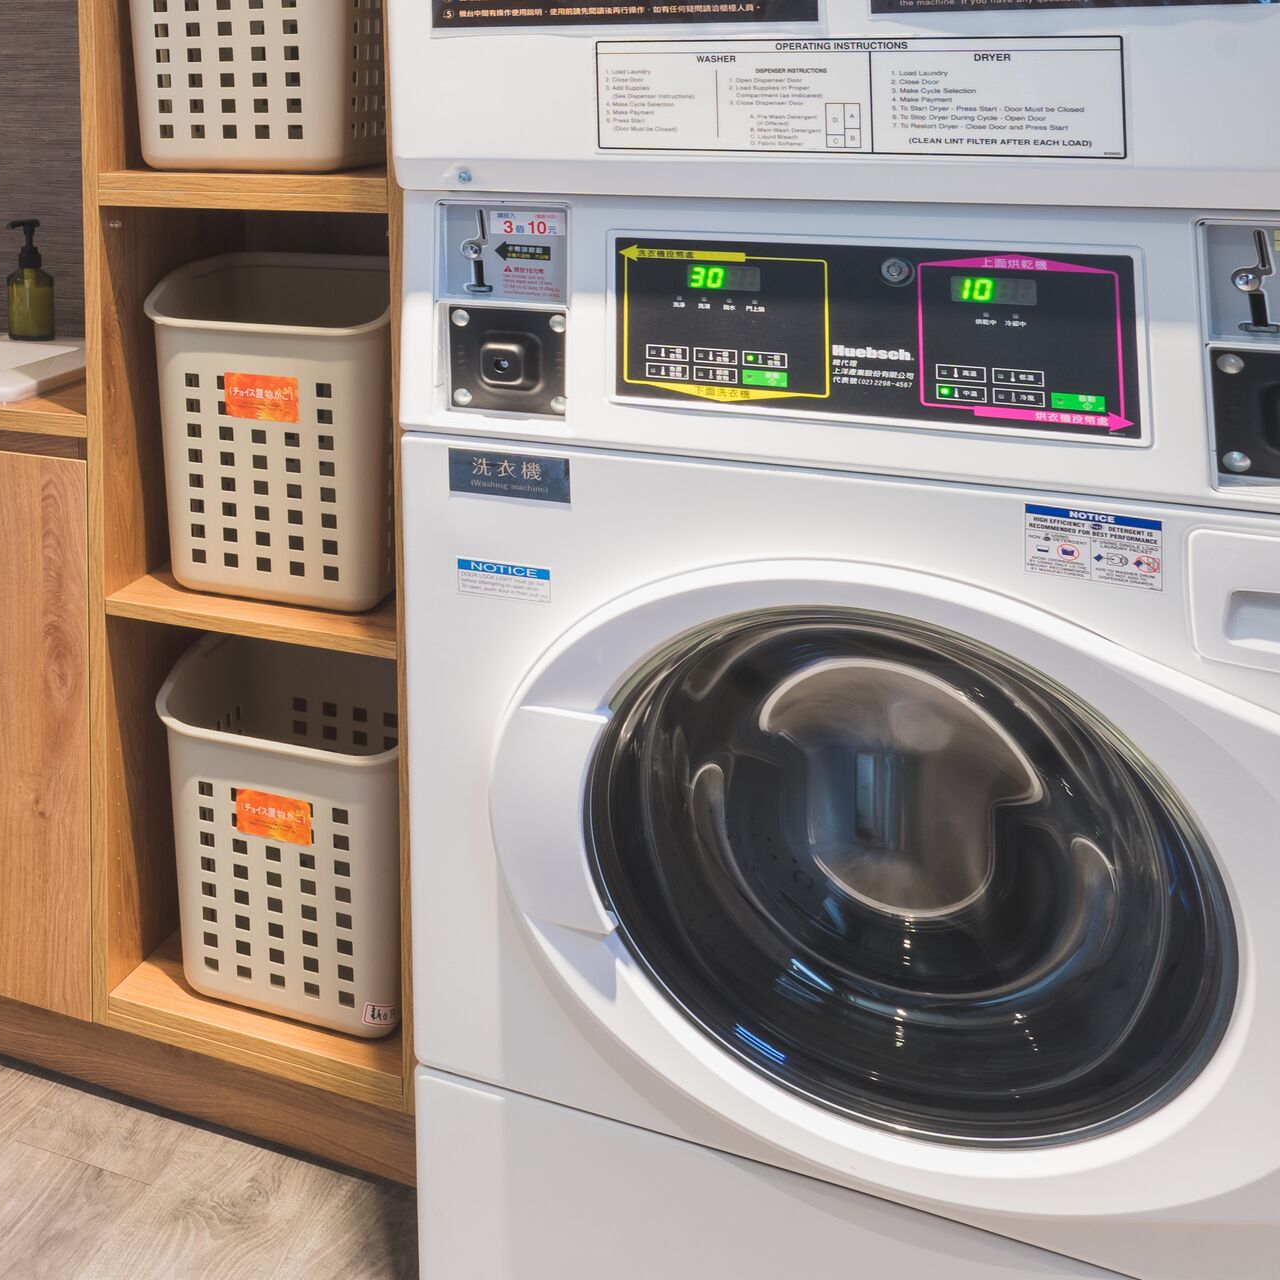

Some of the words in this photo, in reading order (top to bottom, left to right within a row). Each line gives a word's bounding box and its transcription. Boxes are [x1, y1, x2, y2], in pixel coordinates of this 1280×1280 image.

[775, 42, 831, 51] OPERATING
[833, 41, 908, 51] INSTRUCTIONS
[696, 55, 736, 63] WASHER
[973, 53, 1011, 62] DRYER
[1062, 139, 1092, 148] LOAD)
[981, 259, 1048, 270] 上面烘乾機
[691, 266, 725, 289] 30
[961, 278, 993, 300] 10
[696, 386, 750, 399] 下面洗衣機
[472, 457, 542, 481] 洗衣機
[471, 480, 509, 490] (Washing
[511, 483, 549, 494] machine)
[1069, 511, 1116, 524] NOTICE
[1049, 518, 1086, 528] EFFICIENCY
[1108, 526, 1145, 536] DETERGENT
[1029, 523, 1076, 533] RECOMMENDED
[1109, 534, 1158, 545] PERFORMANCE
[470, 561, 538, 578] NOTICE
